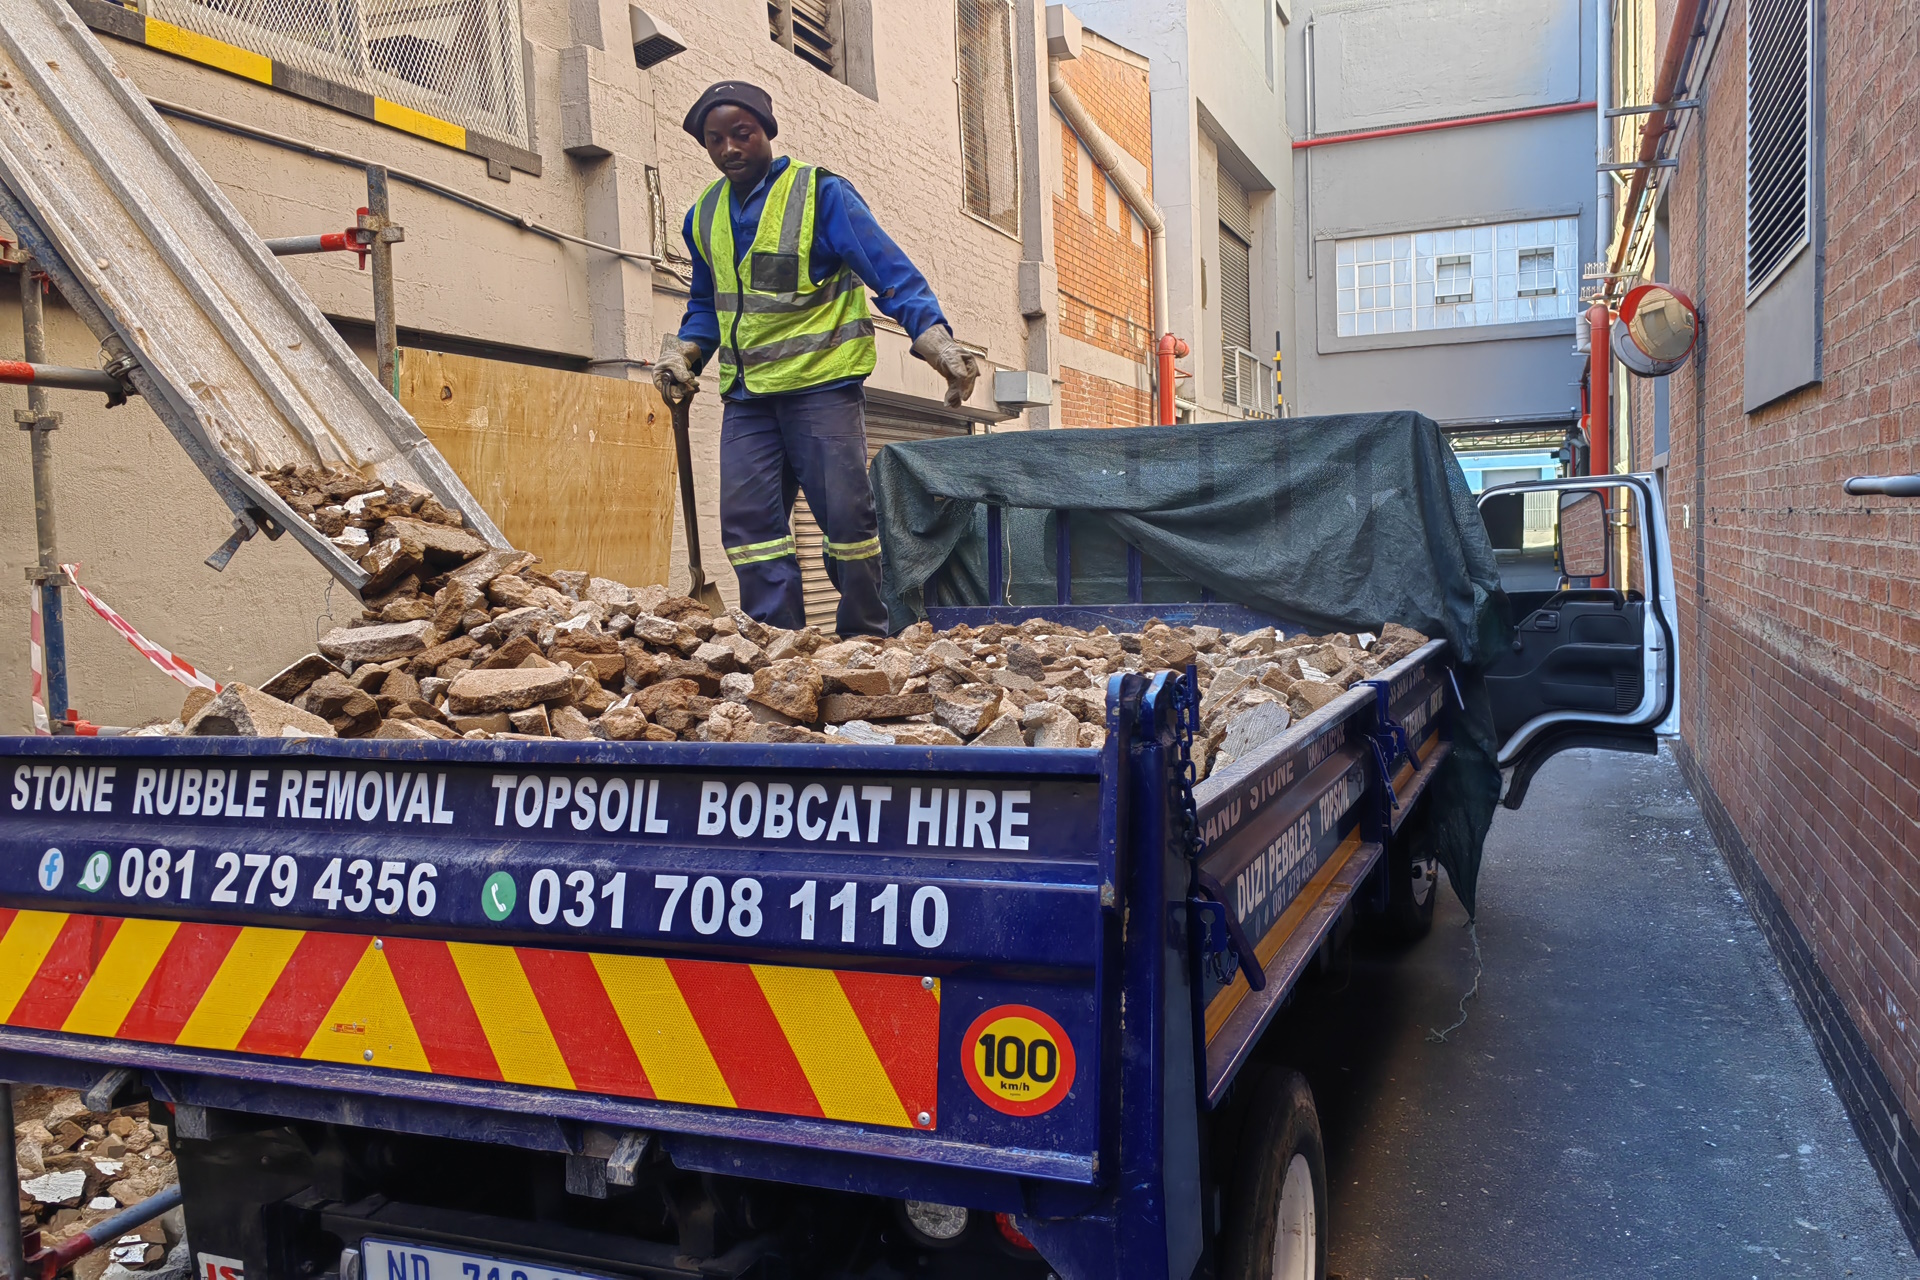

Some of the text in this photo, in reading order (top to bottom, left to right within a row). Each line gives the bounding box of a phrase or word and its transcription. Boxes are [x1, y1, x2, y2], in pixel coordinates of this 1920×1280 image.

[11, 765, 1031, 851] STONE RUBBLE REMOVAL TOPSOIL BOBCAT HIRE
[118, 847, 438, 917] 081 279 4356
[1236, 775, 1350, 925] DUZI PEBBLES TOPSOIL
[1272, 847, 1317, 917] 081 279 4356
[528, 868, 949, 949] 031 708 1110
[978, 1033, 1057, 1083] 100
[1000, 1080, 1031, 1091] km/h
